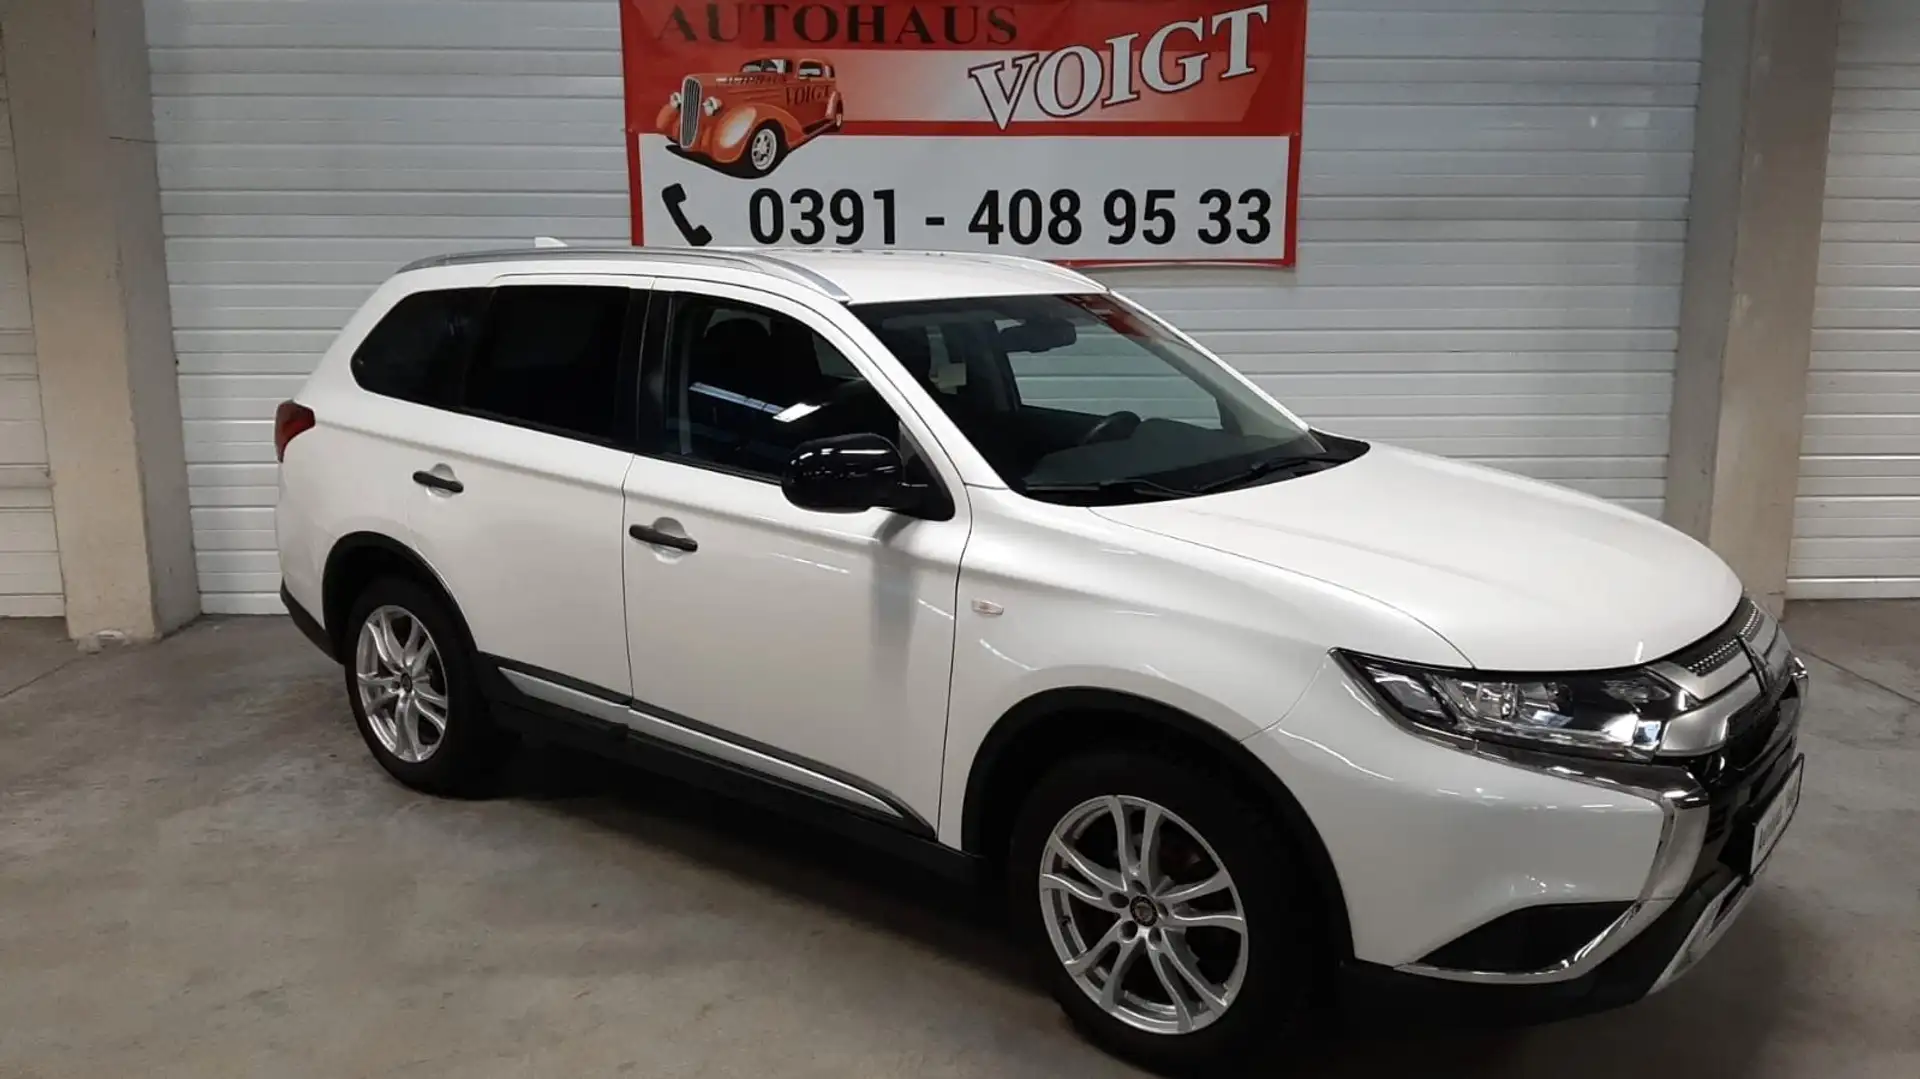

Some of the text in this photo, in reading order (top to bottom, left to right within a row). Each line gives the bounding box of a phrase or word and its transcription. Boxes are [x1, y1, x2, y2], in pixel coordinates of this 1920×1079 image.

[658, 3, 1018, 45] AUTOHAUS
[967, 3, 1268, 130] VOIGT
[785, 84, 831, 105] VOIGT
[749, 187, 896, 246] 0391
[968, 188, 1082, 246] 408
[1103, 188, 1176, 245] 95
[1197, 188, 1271, 245] 33
